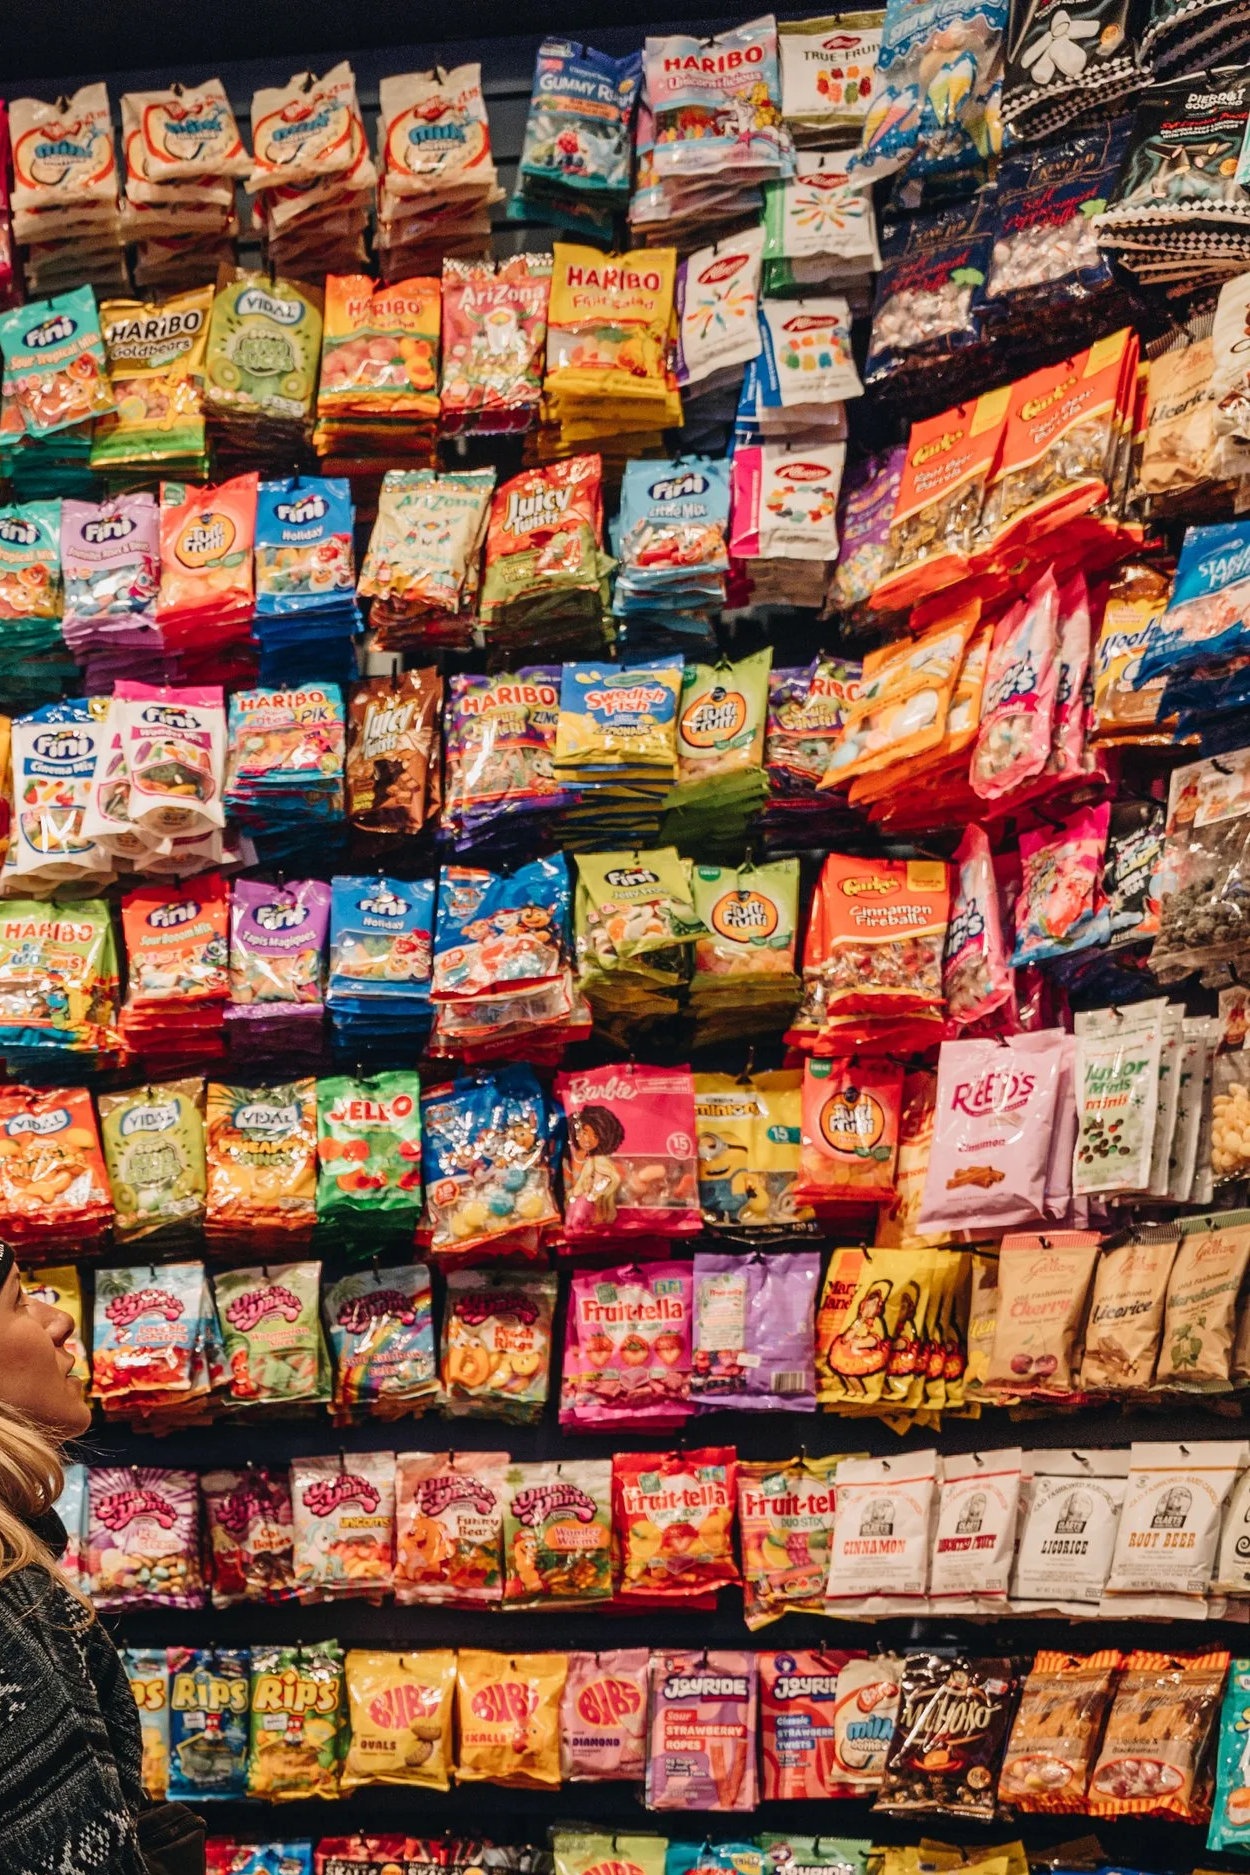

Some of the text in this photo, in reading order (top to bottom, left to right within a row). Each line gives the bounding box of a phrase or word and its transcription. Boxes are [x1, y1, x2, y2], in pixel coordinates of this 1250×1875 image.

[664, 45, 765, 75] HARIBO
[566, 266, 661, 291] HARIBO
[460, 285, 546, 308] AriZona
[247, 296, 297, 317] VIDAL
[347, 300, 421, 317] HARIBO
[26, 318, 73, 347] Fini
[110, 311, 200, 344] HARIBO
[111, 338, 193, 360] Goldbears
[652, 476, 706, 498] Fini
[277, 501, 327, 522] Fini
[399, 493, 480, 511] AriZona
[505, 485, 571, 523] Juicy
[83, 518, 135, 541] Fini
[281, 524, 324, 542] Holiday
[513, 510, 560, 537] Twists
[239, 691, 324, 711] HARIBO
[462, 686, 557, 715] HARIBO
[584, 689, 666, 708] Swedish
[604, 700, 650, 714] Fish
[144, 708, 200, 727] Fini
[364, 700, 414, 739] Juicy
[35, 733, 94, 757] Fini
[606, 872, 659, 887] Fini
[148, 906, 198, 928] Fini
[256, 906, 308, 930] Fini
[358, 900, 411, 917] Fini
[730, 901, 764, 916] Tutti
[849, 905, 933, 918] Cinnamon
[362, 916, 405, 930] Holiday
[722, 913, 769, 928] Frutti
[855, 914, 927, 927] Fireballs
[5, 922, 93, 942] HARIBO
[242, 930, 269, 945] Tapis
[1085, 1058, 1149, 1077] Junior
[568, 1079, 639, 1102] Barbie
[1089, 1077, 1131, 1095] Mints
[329, 1095, 414, 1123] JELL-O
[1085, 1095, 1127, 1110] minis
[773, 1126, 787, 1140] 15
[958, 1139, 1006, 1153] Cinnamon
[582, 1298, 683, 1323] Fruit-tella
[1093, 1298, 1153, 1324] Licorice
[494, 1327, 534, 1340] Peach
[624, 1489, 727, 1513] Fruit-tella
[781, 1517, 823, 1528] DUO STIX
[842, 1539, 907, 1556] CINNAMON
[1040, 1540, 1089, 1555] LICORICE
[1128, 1532, 1197, 1548] ROOT BEER
[171, 1675, 248, 1712] Rips
[253, 1677, 338, 1713] Rips
[665, 1677, 748, 1698] JOYRIDE
[667, 1711, 690, 1722] Sour
[666, 1726, 743, 1737] STRAWBERRY
[571, 1737, 621, 1747] DIAMOND
[667, 1740, 701, 1751] ROPES
